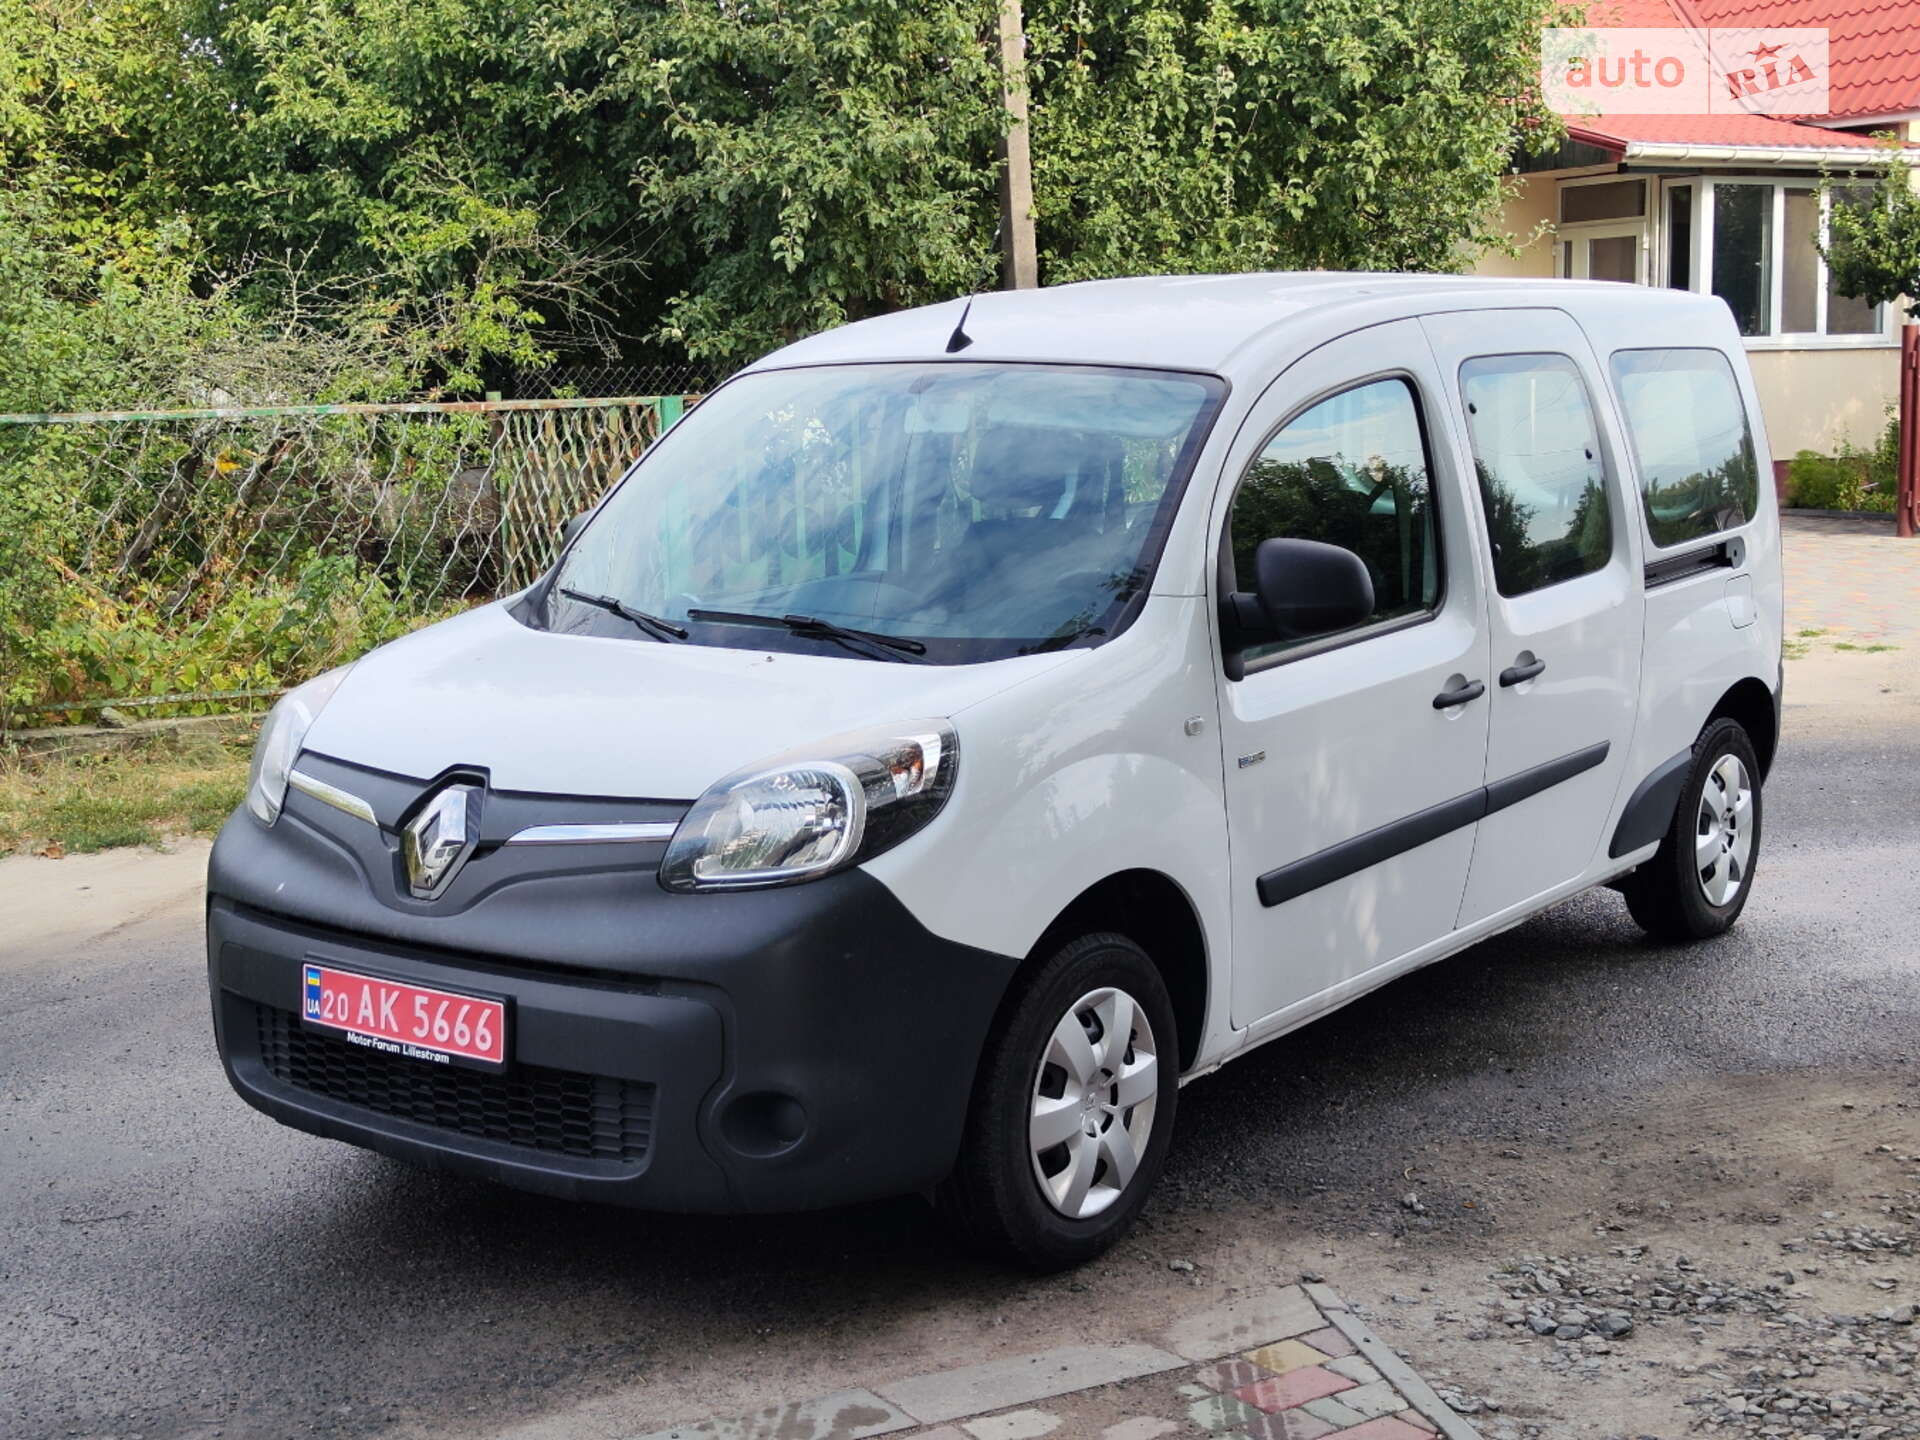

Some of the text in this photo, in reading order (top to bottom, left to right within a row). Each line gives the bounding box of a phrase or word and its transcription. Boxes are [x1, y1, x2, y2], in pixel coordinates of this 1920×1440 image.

[307, 999, 321, 1015] UA
[323, 984, 493, 1051] 20 AK 5666
